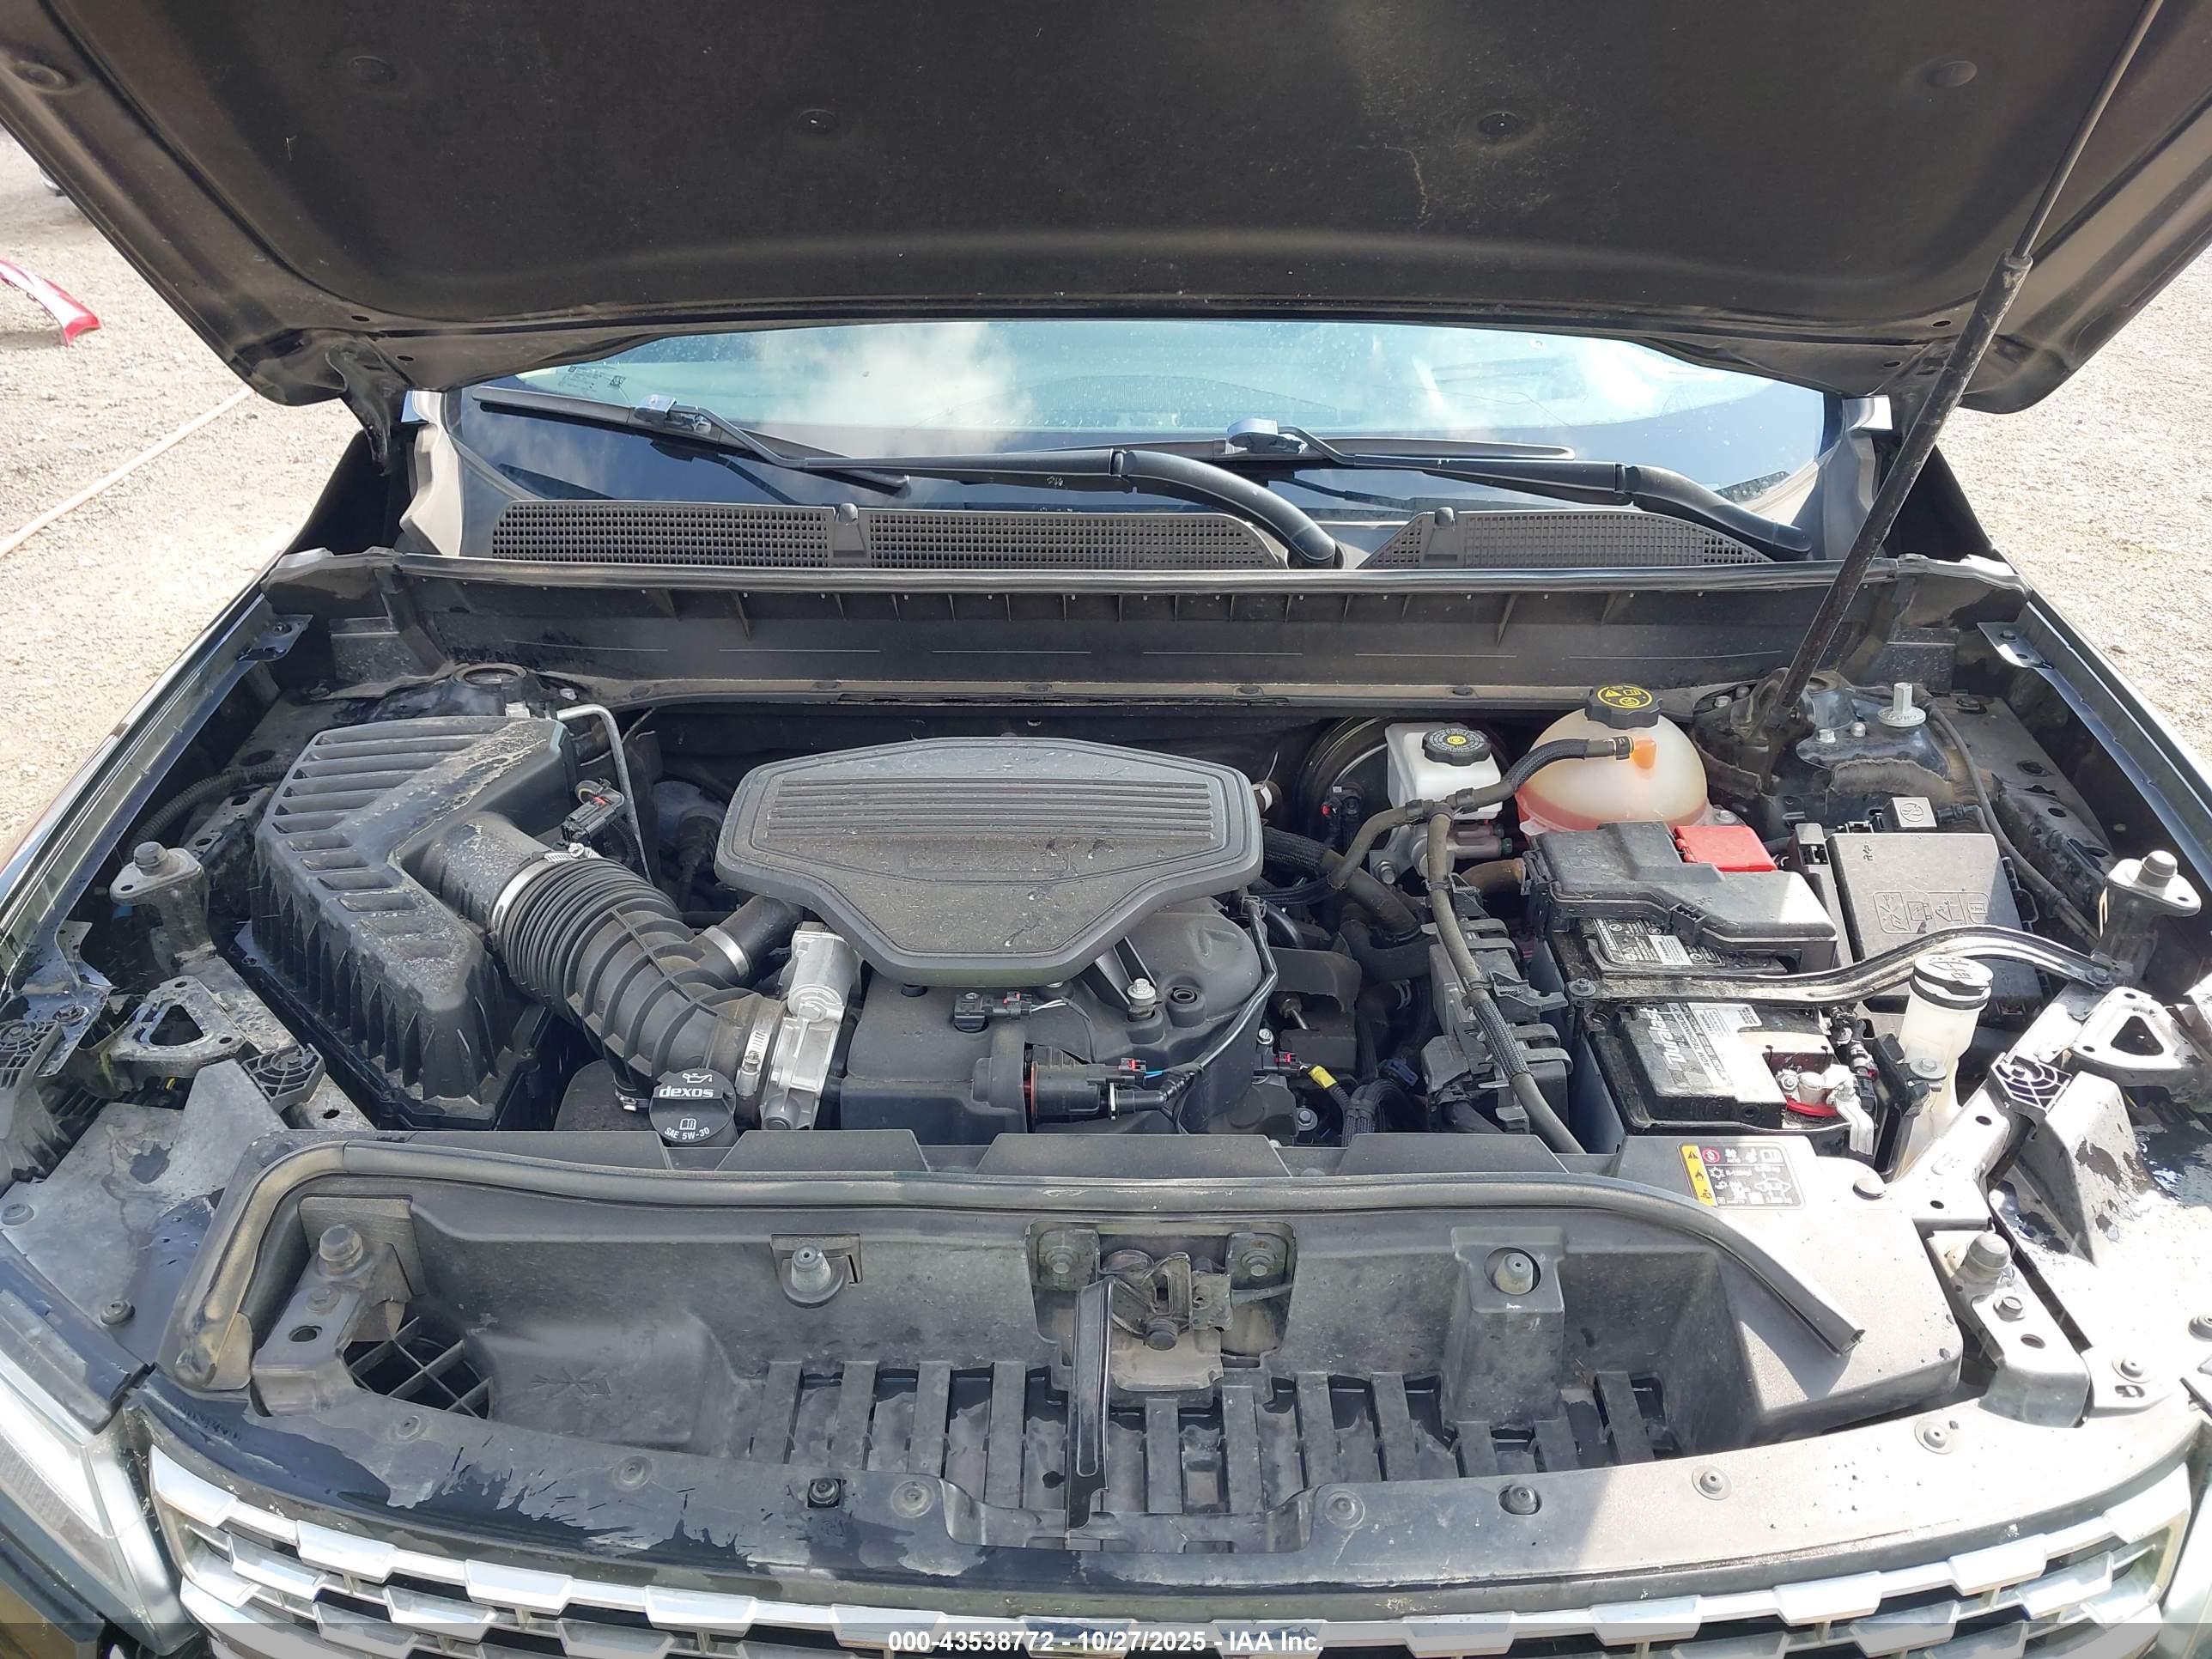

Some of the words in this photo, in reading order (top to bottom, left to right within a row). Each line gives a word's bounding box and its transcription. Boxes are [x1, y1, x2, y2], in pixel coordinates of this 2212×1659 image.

[1639, 1006, 1687, 1066] Duralast
[659, 1085, 714, 1098] dexos
[664, 1127, 680, 1139] SAE
[682, 1127, 710, 1140] 5W-30
